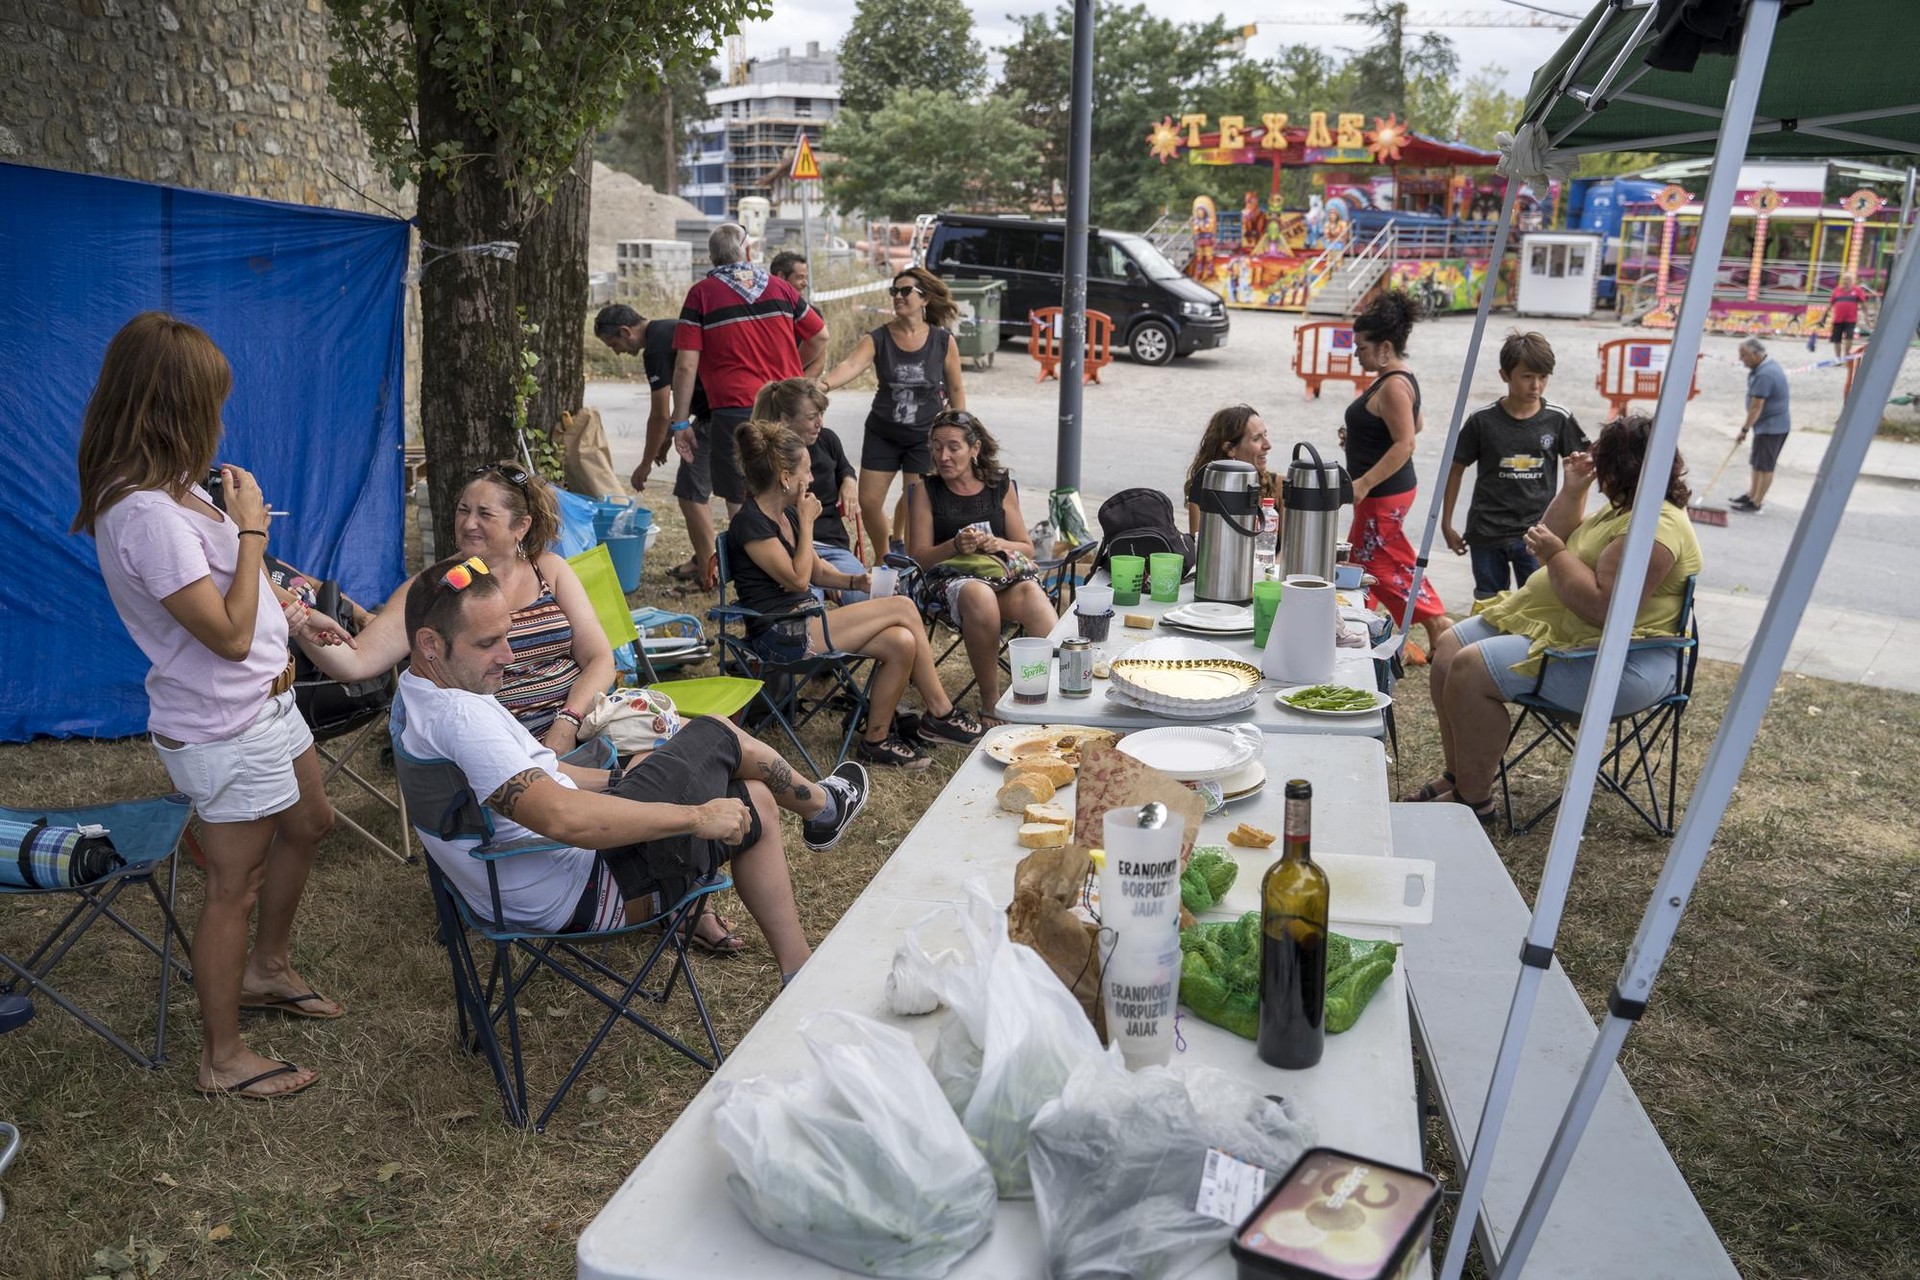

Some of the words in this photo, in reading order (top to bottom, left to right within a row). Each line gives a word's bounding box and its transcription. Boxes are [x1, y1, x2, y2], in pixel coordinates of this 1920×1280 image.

[1181, 112, 1365, 149] TEXAS
[1023, 662, 1047, 679] Sprite
[1131, 900, 1165, 917] JAIAK
[1125, 1020, 1158, 1037] JAIAK
